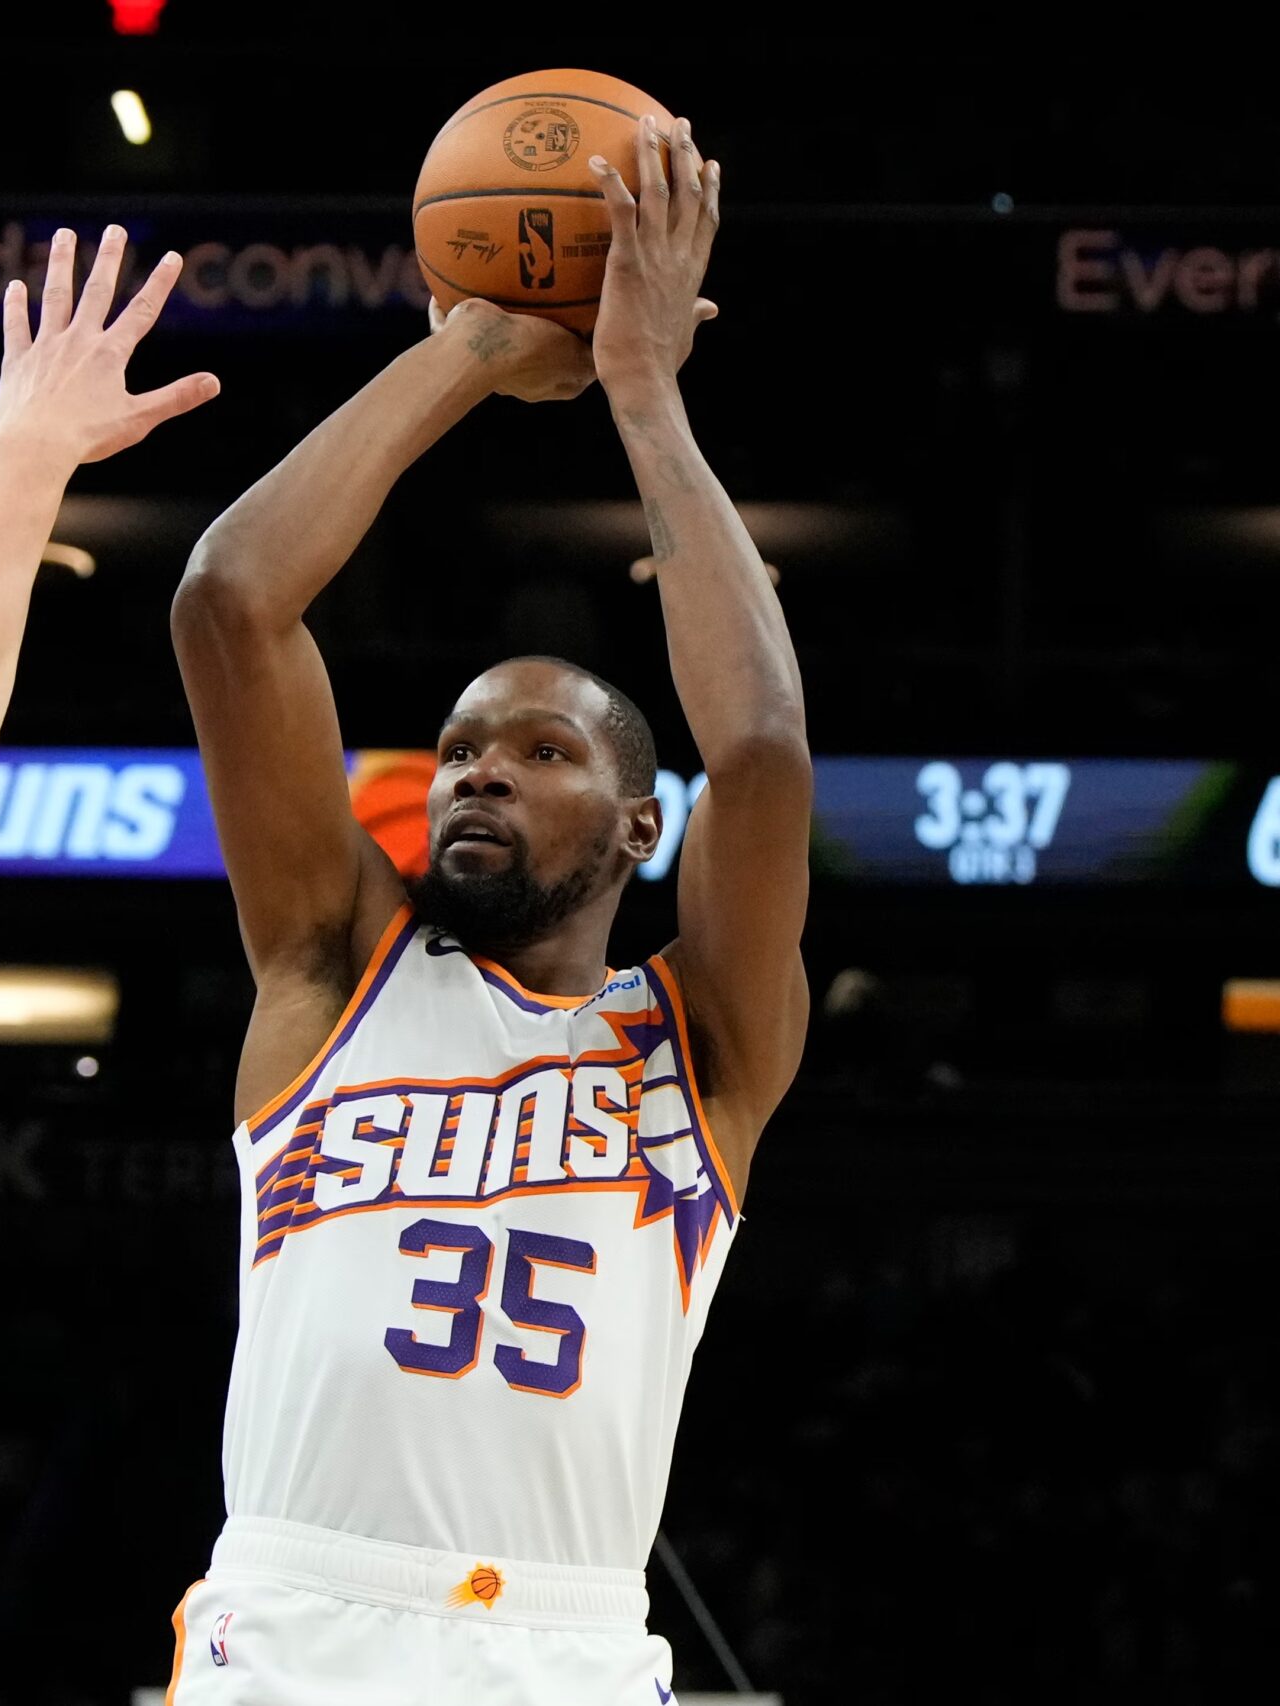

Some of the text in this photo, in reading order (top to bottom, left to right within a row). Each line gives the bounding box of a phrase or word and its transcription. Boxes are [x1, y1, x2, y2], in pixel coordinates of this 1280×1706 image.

[914, 761, 1071, 849] 3:37
[314, 1066, 630, 1211] SUNS
[384, 1218, 597, 1400] 35
